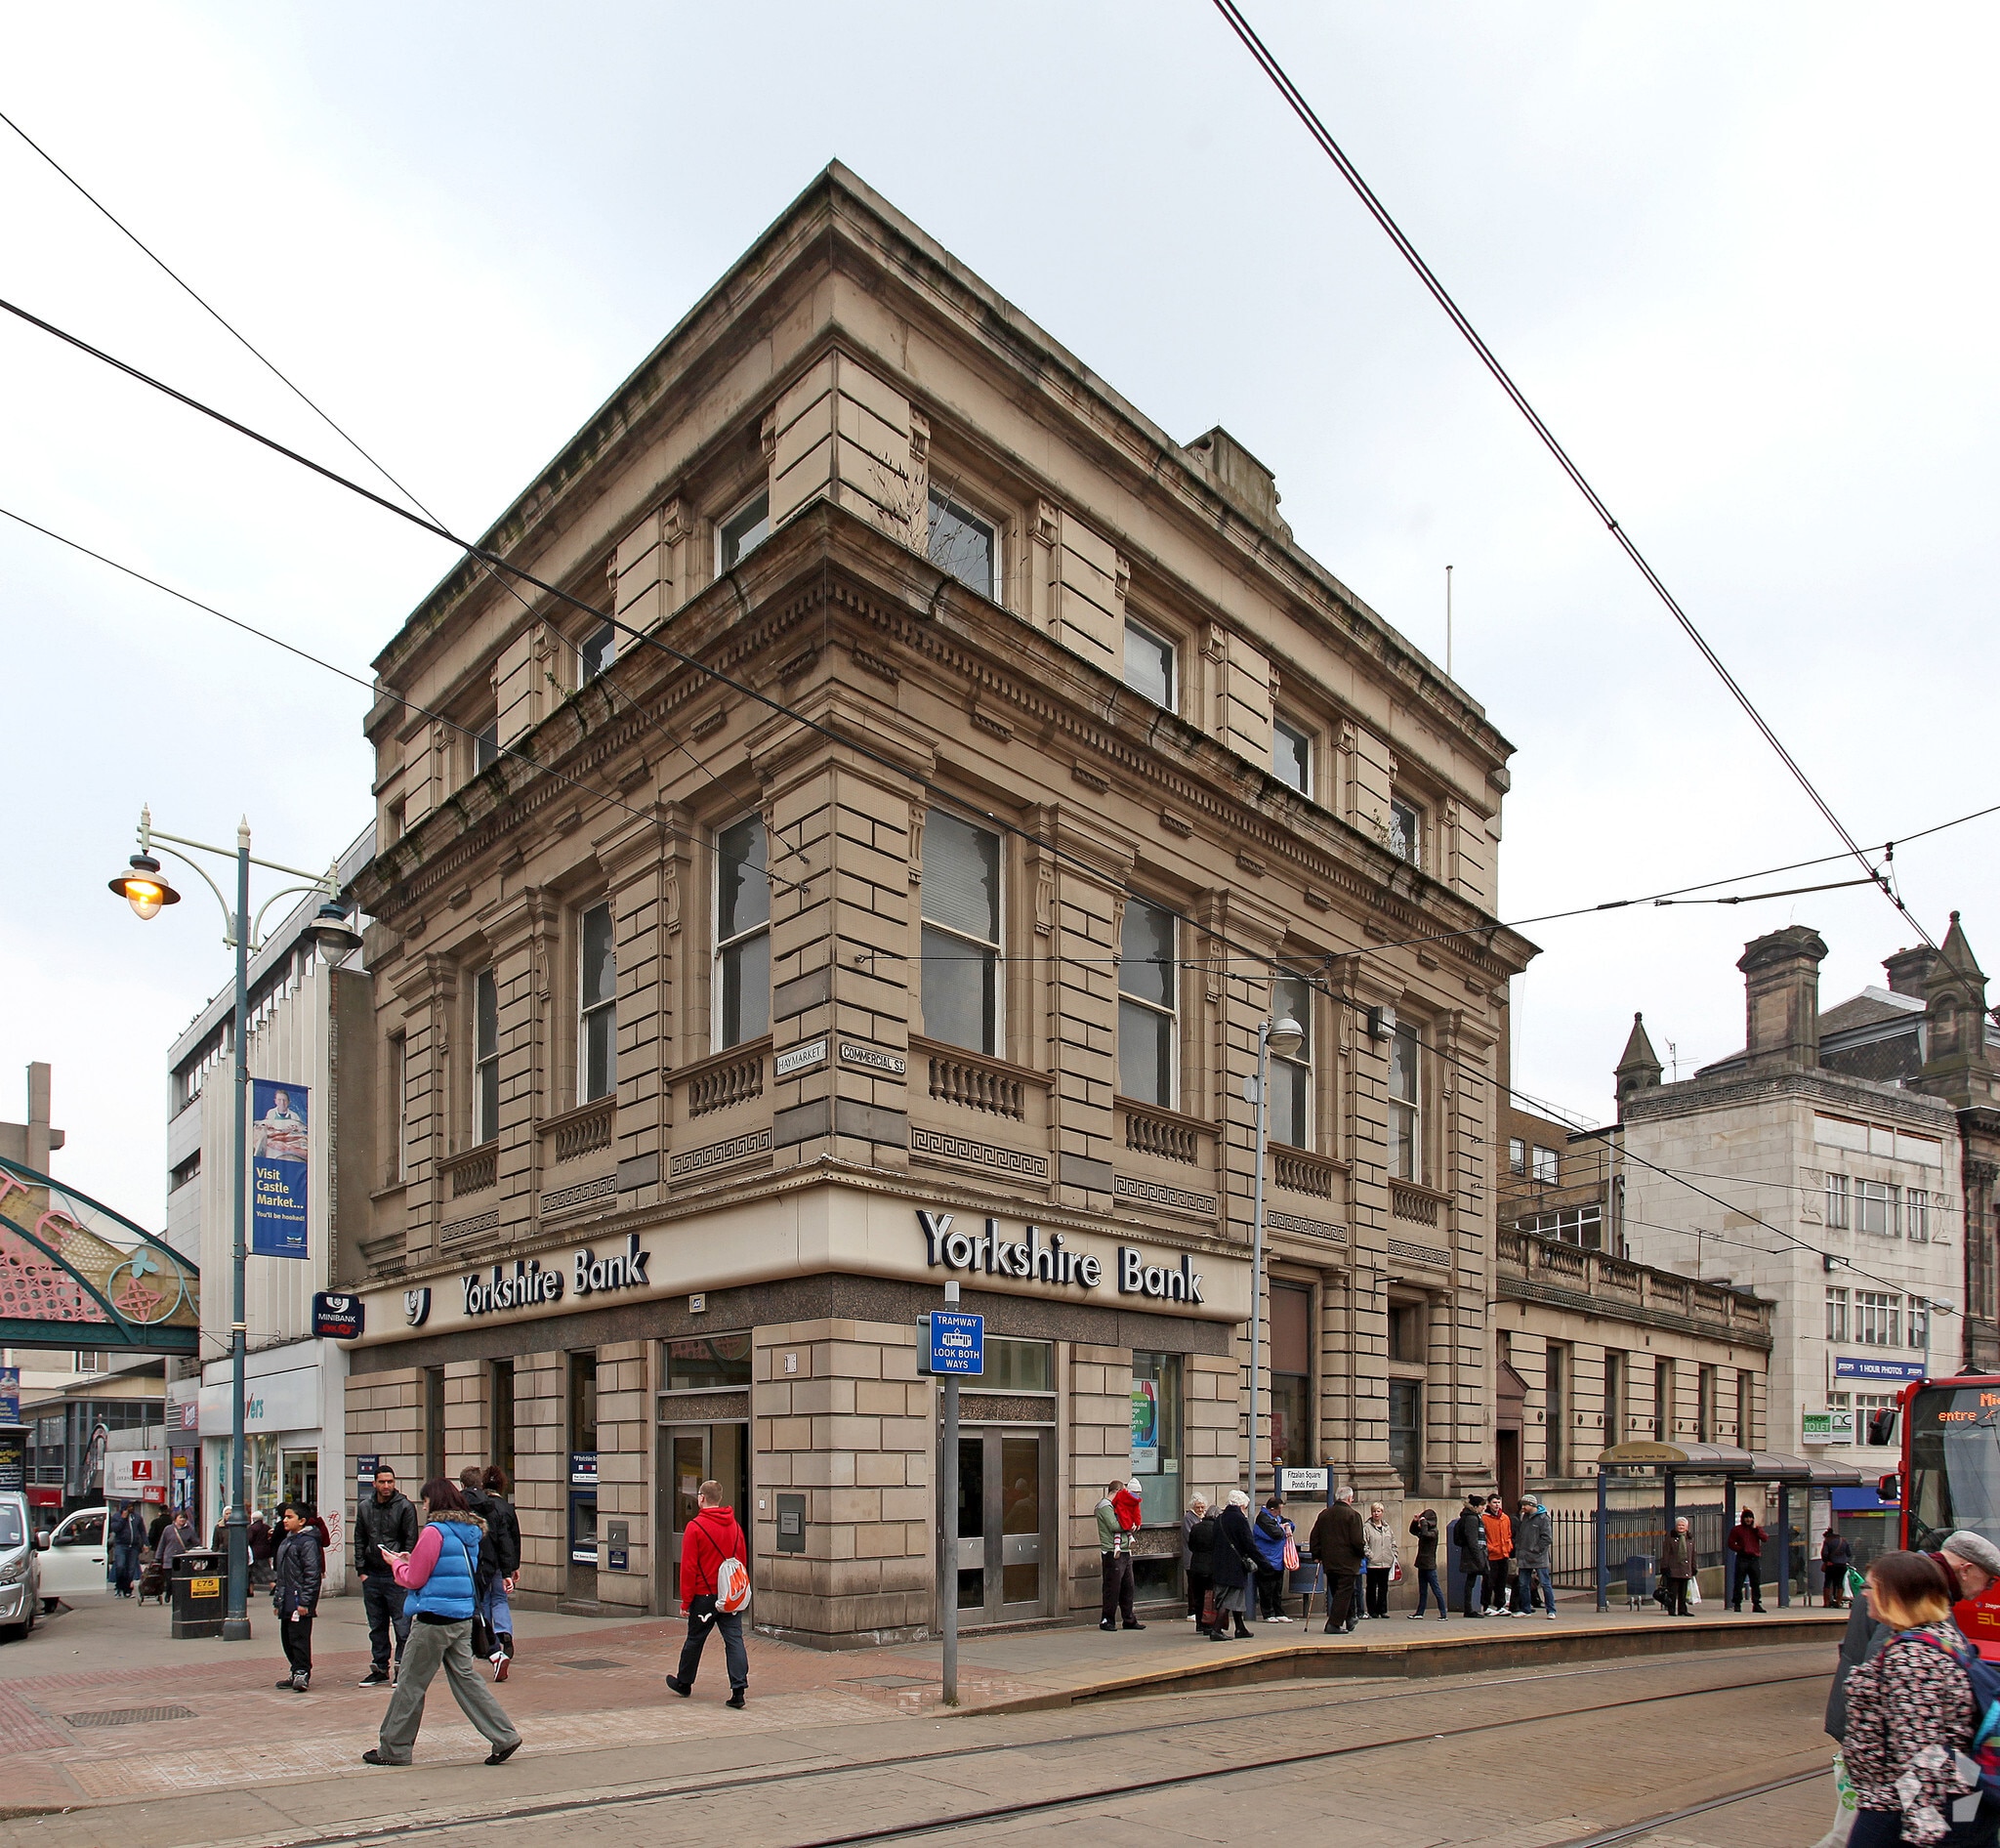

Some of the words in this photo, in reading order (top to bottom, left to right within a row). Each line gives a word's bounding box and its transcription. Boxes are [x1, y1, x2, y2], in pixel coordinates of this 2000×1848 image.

[778, 1046, 821, 1071] HAYMARKET
[844, 1046, 893, 1070] COMMERCIAL
[256, 1167, 280, 1181] Visit
[256, 1180, 289, 1194] Castle
[257, 1195, 304, 1209] Market...
[256, 1210, 272, 1220] You'll
[273, 1211, 281, 1220] be
[915, 1208, 1103, 1288] Yorkshire
[1118, 1245, 1205, 1304] Bank
[460, 1260, 563, 1315] Yorkshire
[573, 1233, 650, 1295] Bank
[318, 1313, 356, 1323] MINIBANK
[938, 1316, 978, 1327] TRAMWAY
[935, 1348, 956, 1358] LOOK
[958, 1350, 979, 1360] BOTH
[945, 1360, 969, 1368] WAYS
[1864, 1365, 1880, 1373] HOUR
[1881, 1365, 1903, 1375] PHOTOS
[244, 1393, 264, 1419] vers
[1805, 1422, 1815, 1431] TO
[1816, 1422, 1829, 1431] LET
